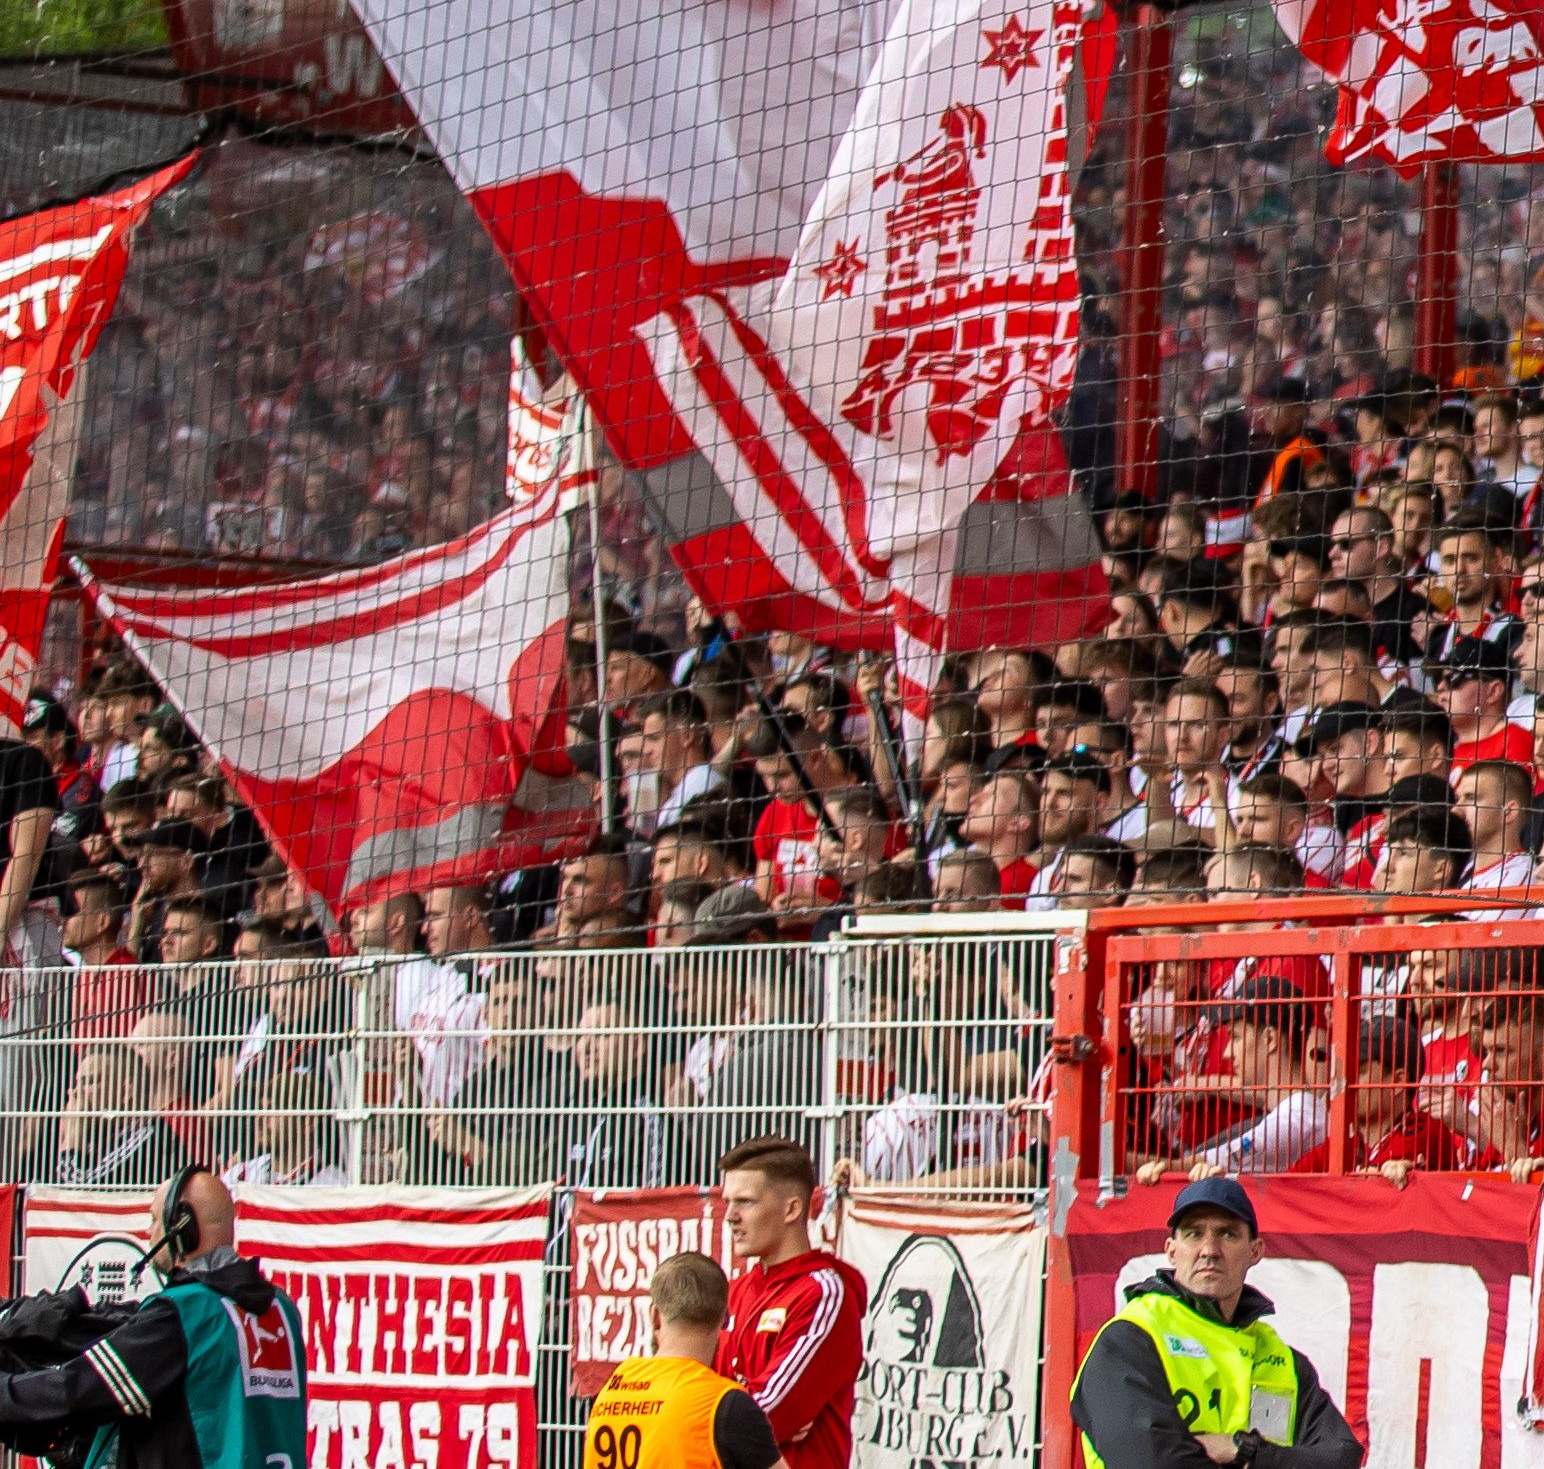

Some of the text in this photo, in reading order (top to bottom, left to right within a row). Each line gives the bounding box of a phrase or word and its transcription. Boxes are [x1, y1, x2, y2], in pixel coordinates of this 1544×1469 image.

[264, 1269, 533, 1379] NTHESIA
[577, 1294, 654, 1363] BEZA
[856, 1356, 1016, 1415] PORT-CLUB
[308, 1398, 522, 1469] TRAS 79
[594, 1424, 642, 1469] 90
